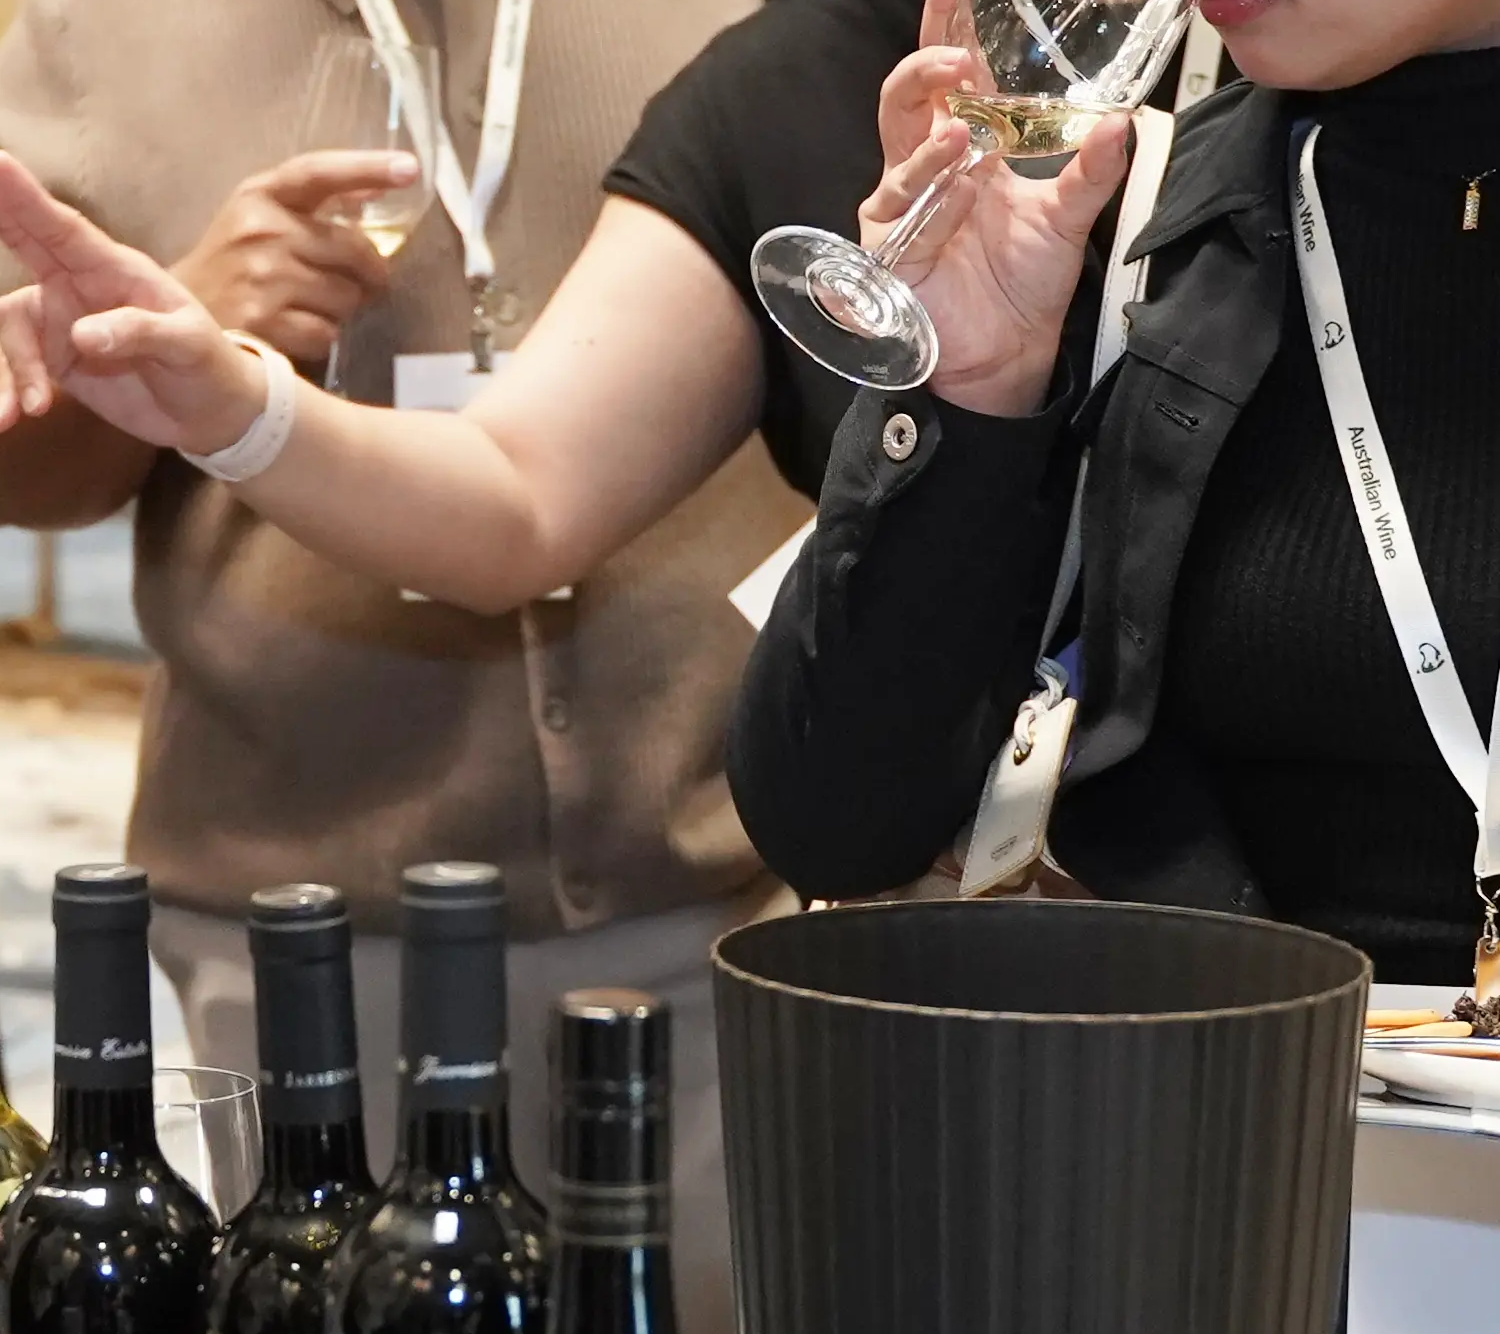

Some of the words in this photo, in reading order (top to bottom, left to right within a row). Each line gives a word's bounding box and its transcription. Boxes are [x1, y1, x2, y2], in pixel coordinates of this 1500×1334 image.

[1300, 204, 1316, 253] Wine
[1347, 426, 1383, 512] Australian
[1374, 512, 1397, 561] Wine
